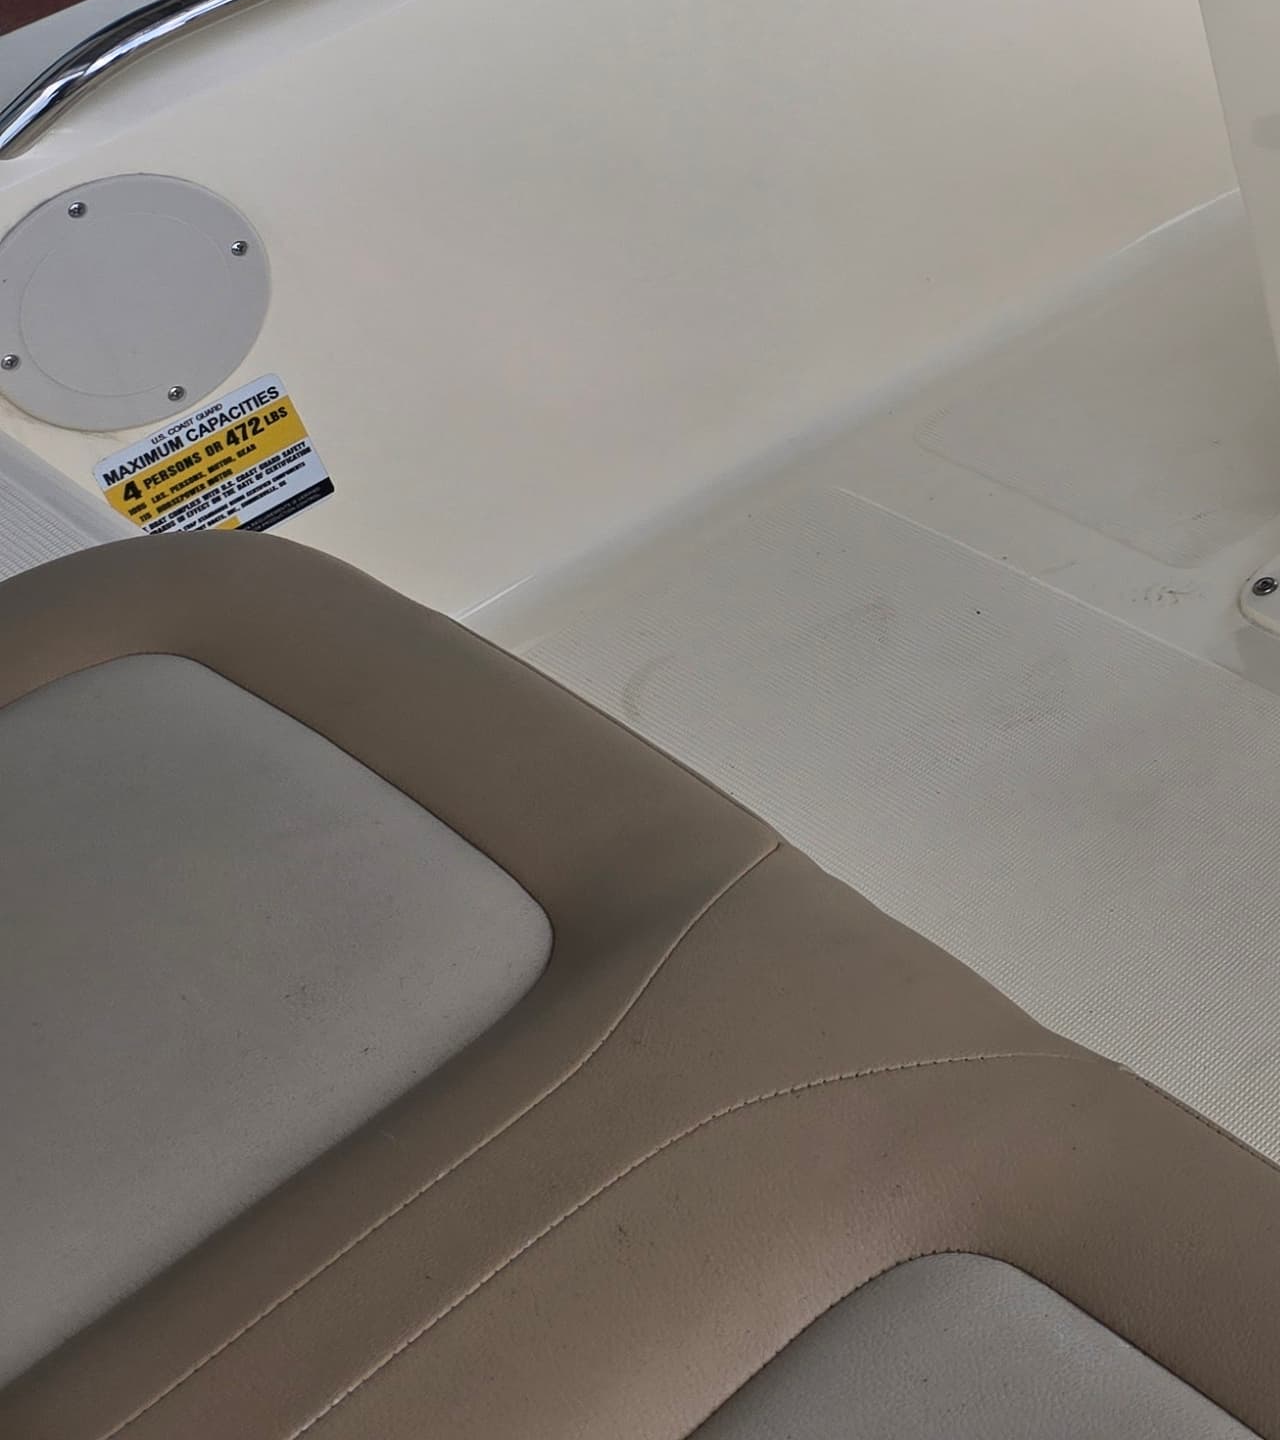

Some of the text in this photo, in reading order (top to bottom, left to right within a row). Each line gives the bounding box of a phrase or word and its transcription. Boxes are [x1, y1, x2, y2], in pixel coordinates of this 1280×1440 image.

[102, 385, 280, 486] MAXIMUM CAPACITIES
[122, 405, 288, 502] 4 PERSONS OR 472 LBS
[150, 402, 223, 445] U.S. COAST GUARD
